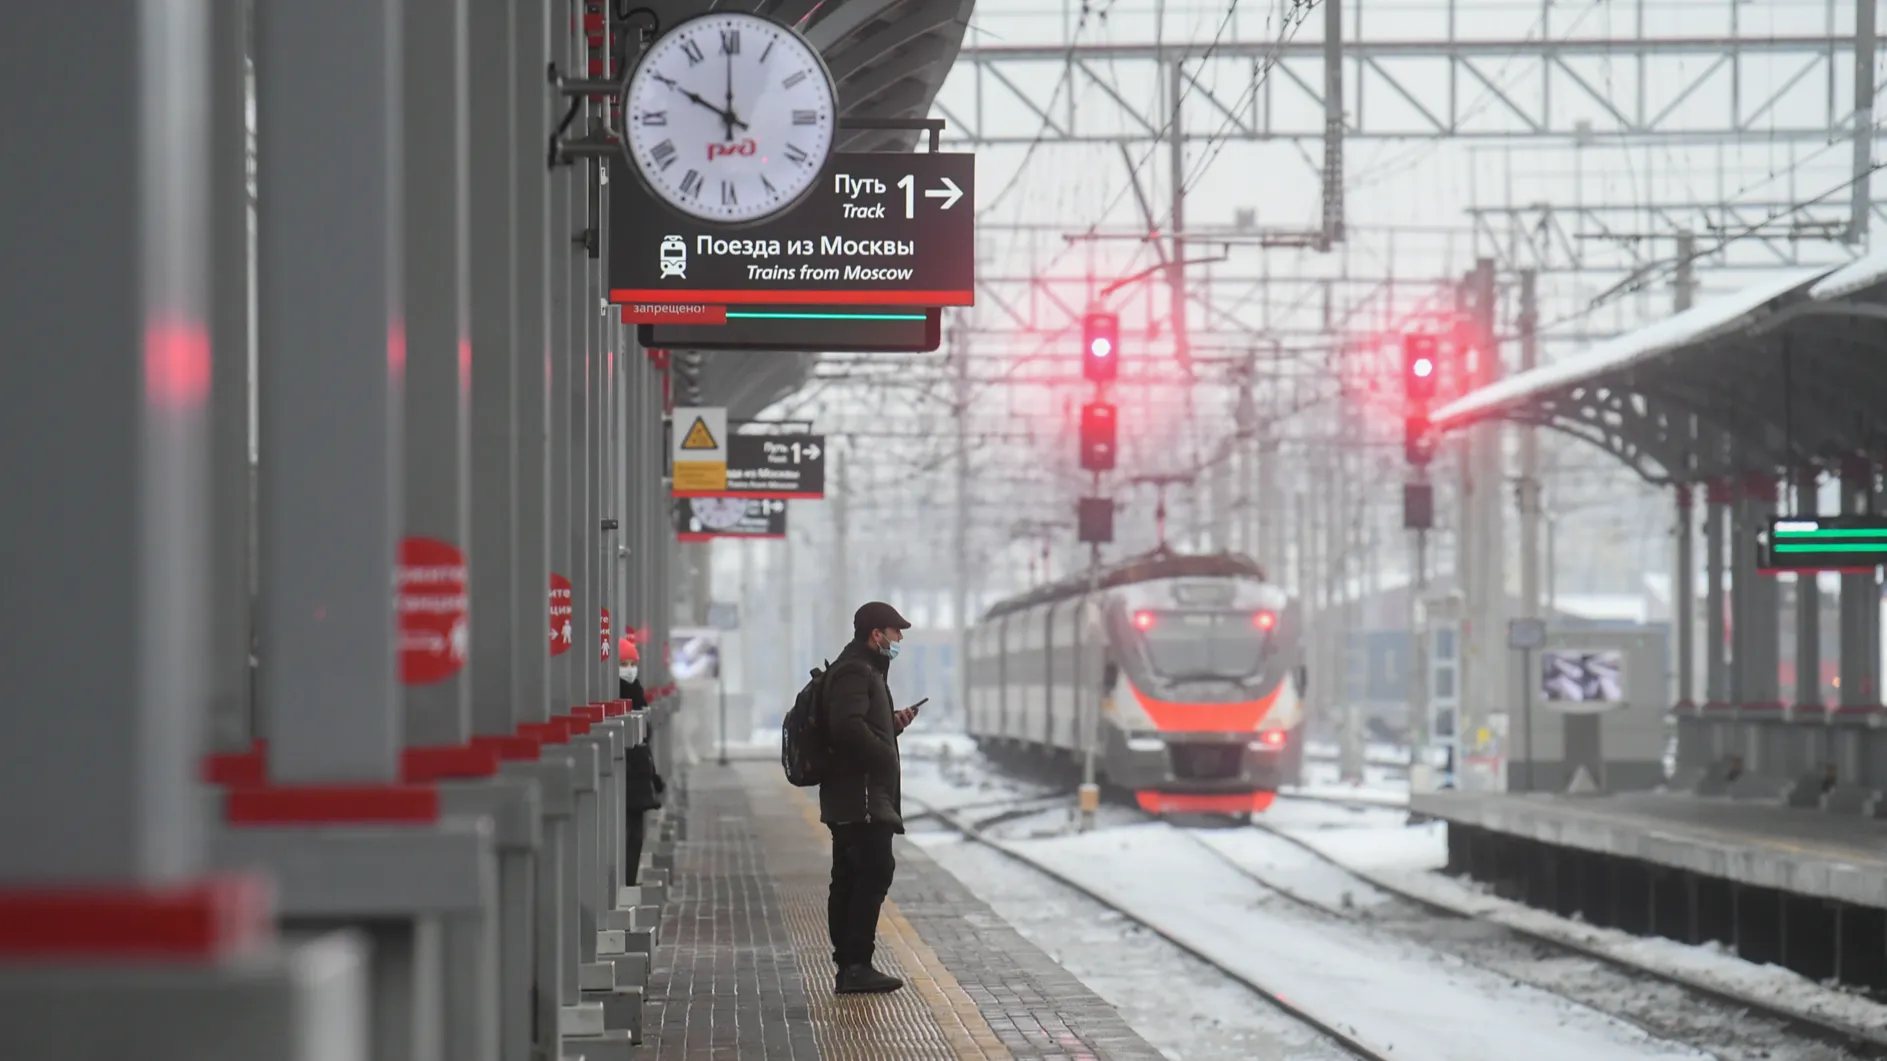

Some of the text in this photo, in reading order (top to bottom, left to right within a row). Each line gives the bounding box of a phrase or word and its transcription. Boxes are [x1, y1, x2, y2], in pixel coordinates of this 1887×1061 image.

[834, 173, 915, 219] Путь 1
[842, 203, 885, 219] Track
[697, 235, 914, 258] Поезда из Москвы
[747, 265, 914, 281] Trains from Moscow
[790, 442, 801, 464] 1
